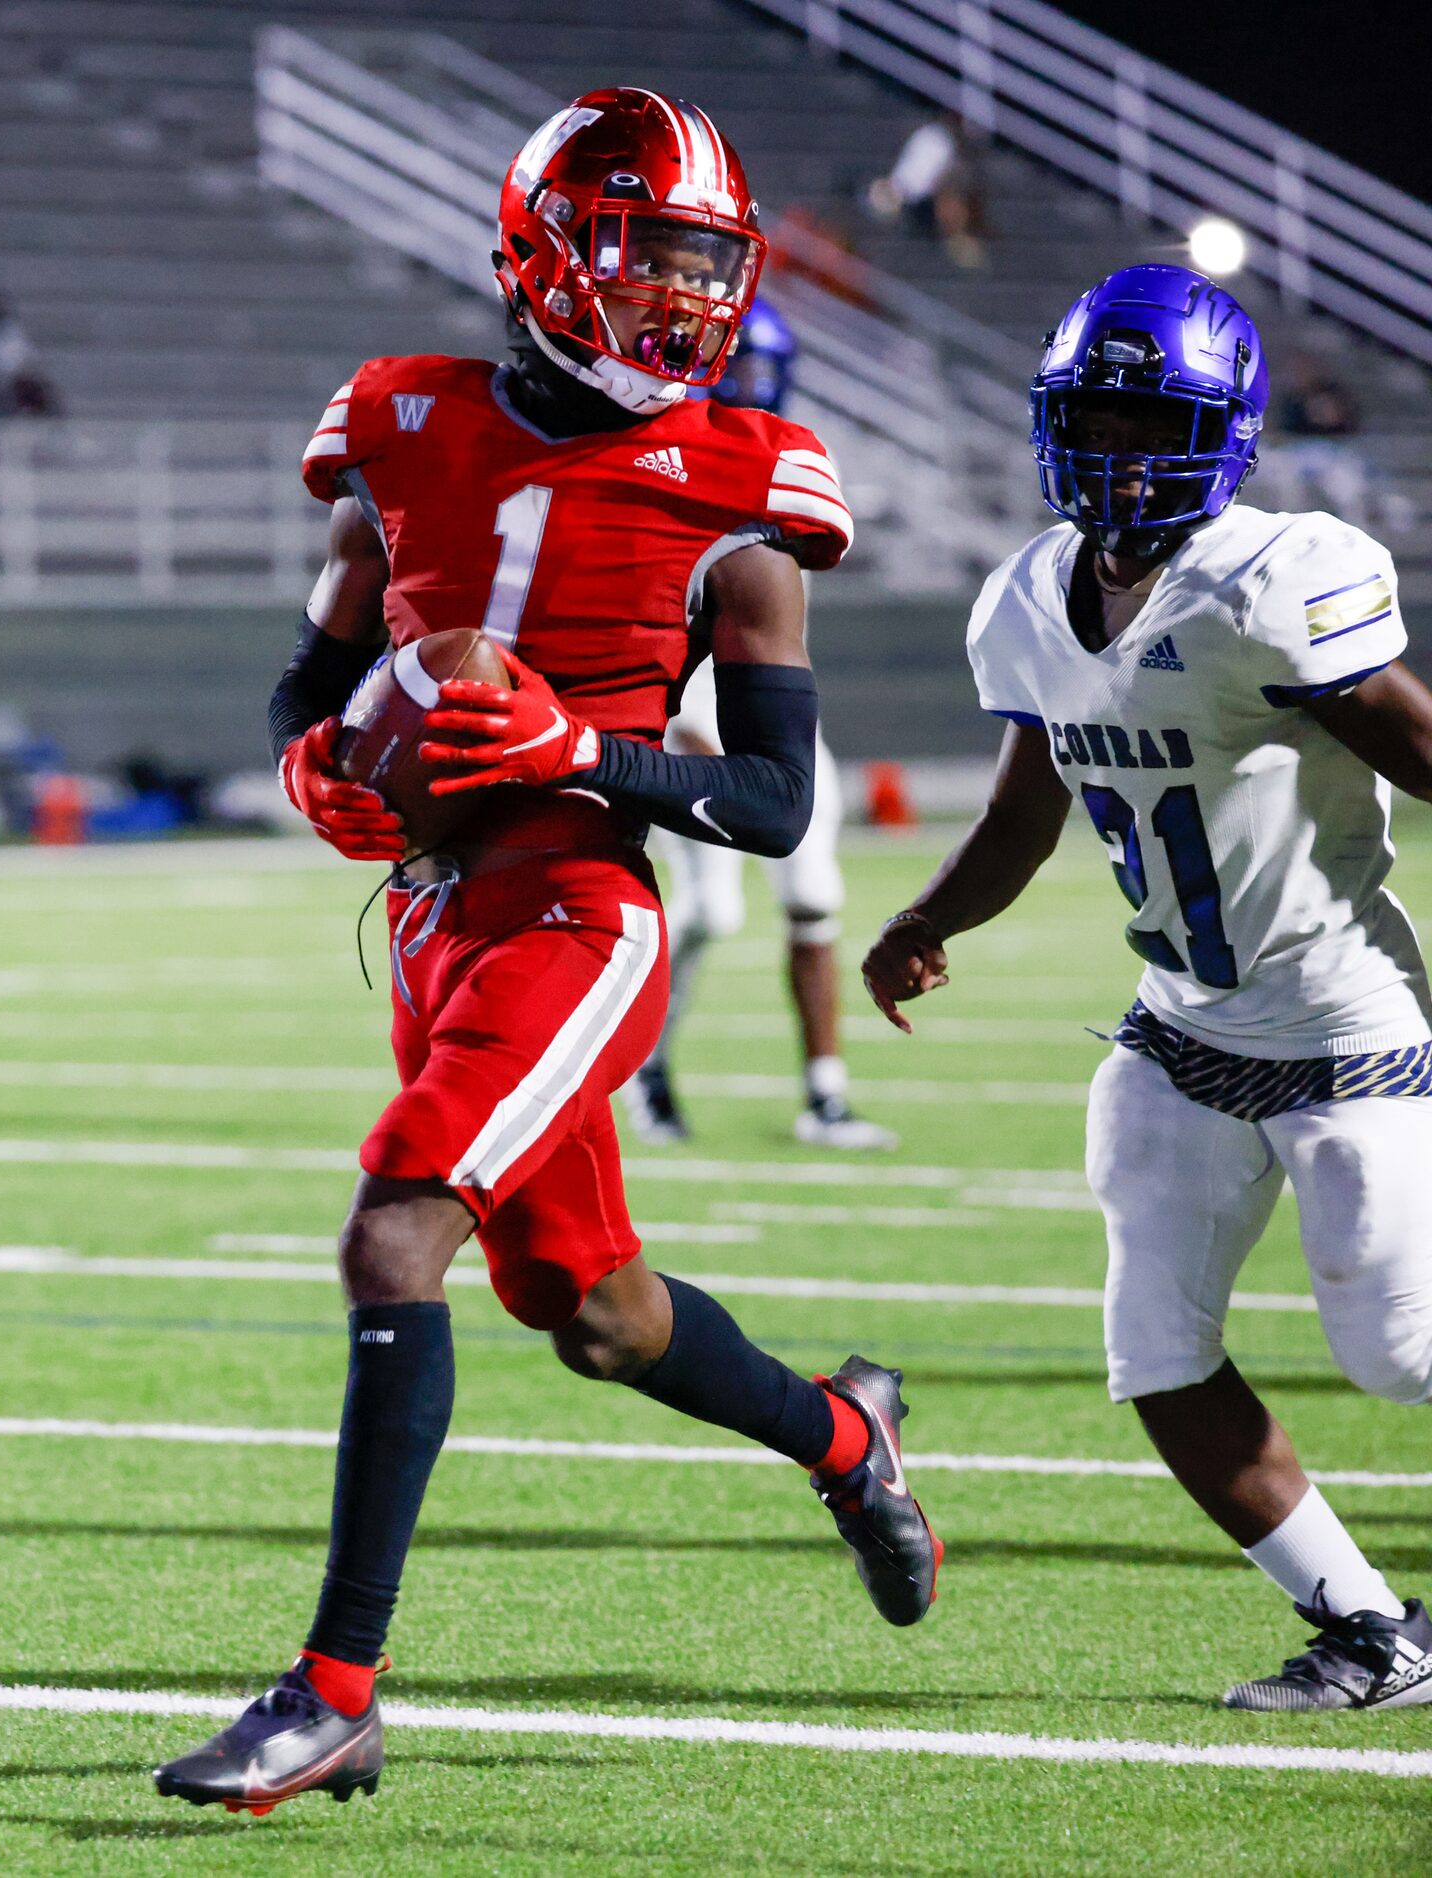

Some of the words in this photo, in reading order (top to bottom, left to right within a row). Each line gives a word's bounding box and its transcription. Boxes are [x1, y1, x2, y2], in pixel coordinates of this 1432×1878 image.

[391, 392, 436, 433] W
[633, 456, 689, 483] adidas
[480, 485, 554, 655] 1
[1139, 657, 1185, 673] adidas
[1051, 721, 1195, 769] CONRAD
[1080, 783, 1240, 990] 21
